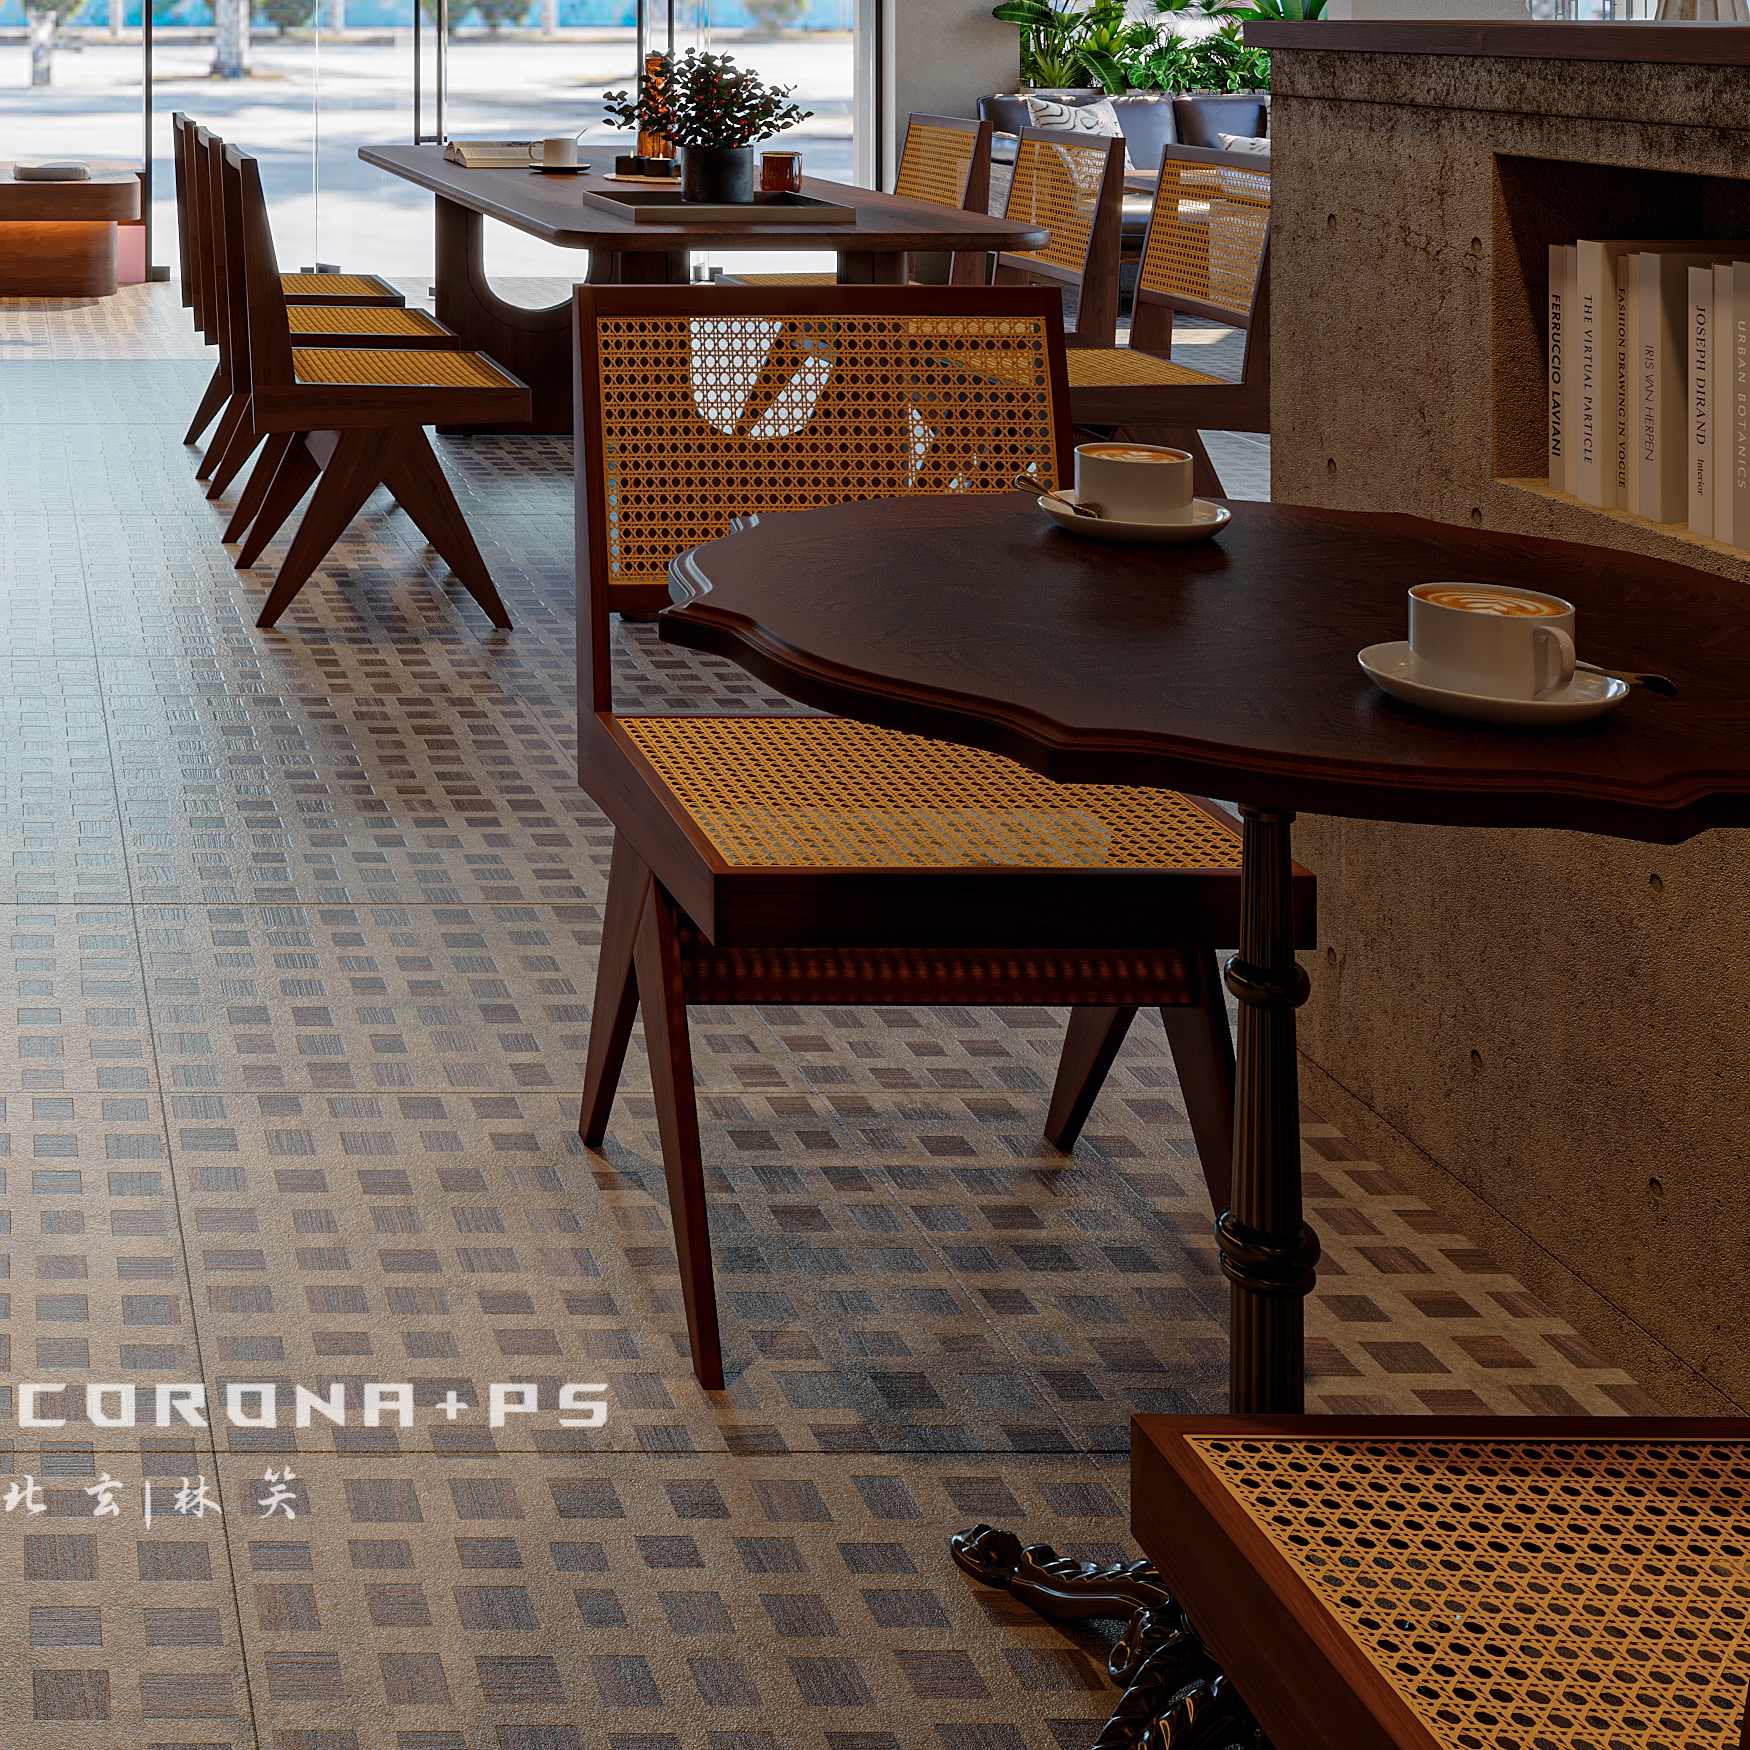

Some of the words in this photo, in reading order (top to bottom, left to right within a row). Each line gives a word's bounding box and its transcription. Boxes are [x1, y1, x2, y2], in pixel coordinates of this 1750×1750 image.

[1551, 294, 1561, 385] FERRUCCIO
[1583, 295, 1593, 323] THE
[1618, 288, 1626, 348] FASHION
[1695, 305, 1706, 371] JOSEPH
[1583, 329, 1593, 391] VIRTUAL
[1644, 345, 1655, 370] IRIS
[1737, 320, 1747, 383] URBAN
[1618, 352, 1626, 417] DRAWING
[1644, 373, 1655, 402] VAN
[1695, 376, 1706, 445] DIRAND
[1551, 391, 1561, 457] LAVIANI
[1583, 396, 1593, 464] PARTICLE
[1618, 420, 1626, 437] IN
[1644, 406, 1655, 462] HERPEN
[1737, 393, 1747, 489] BOTANICS
[1618, 439, 1626, 488] VOGUE
